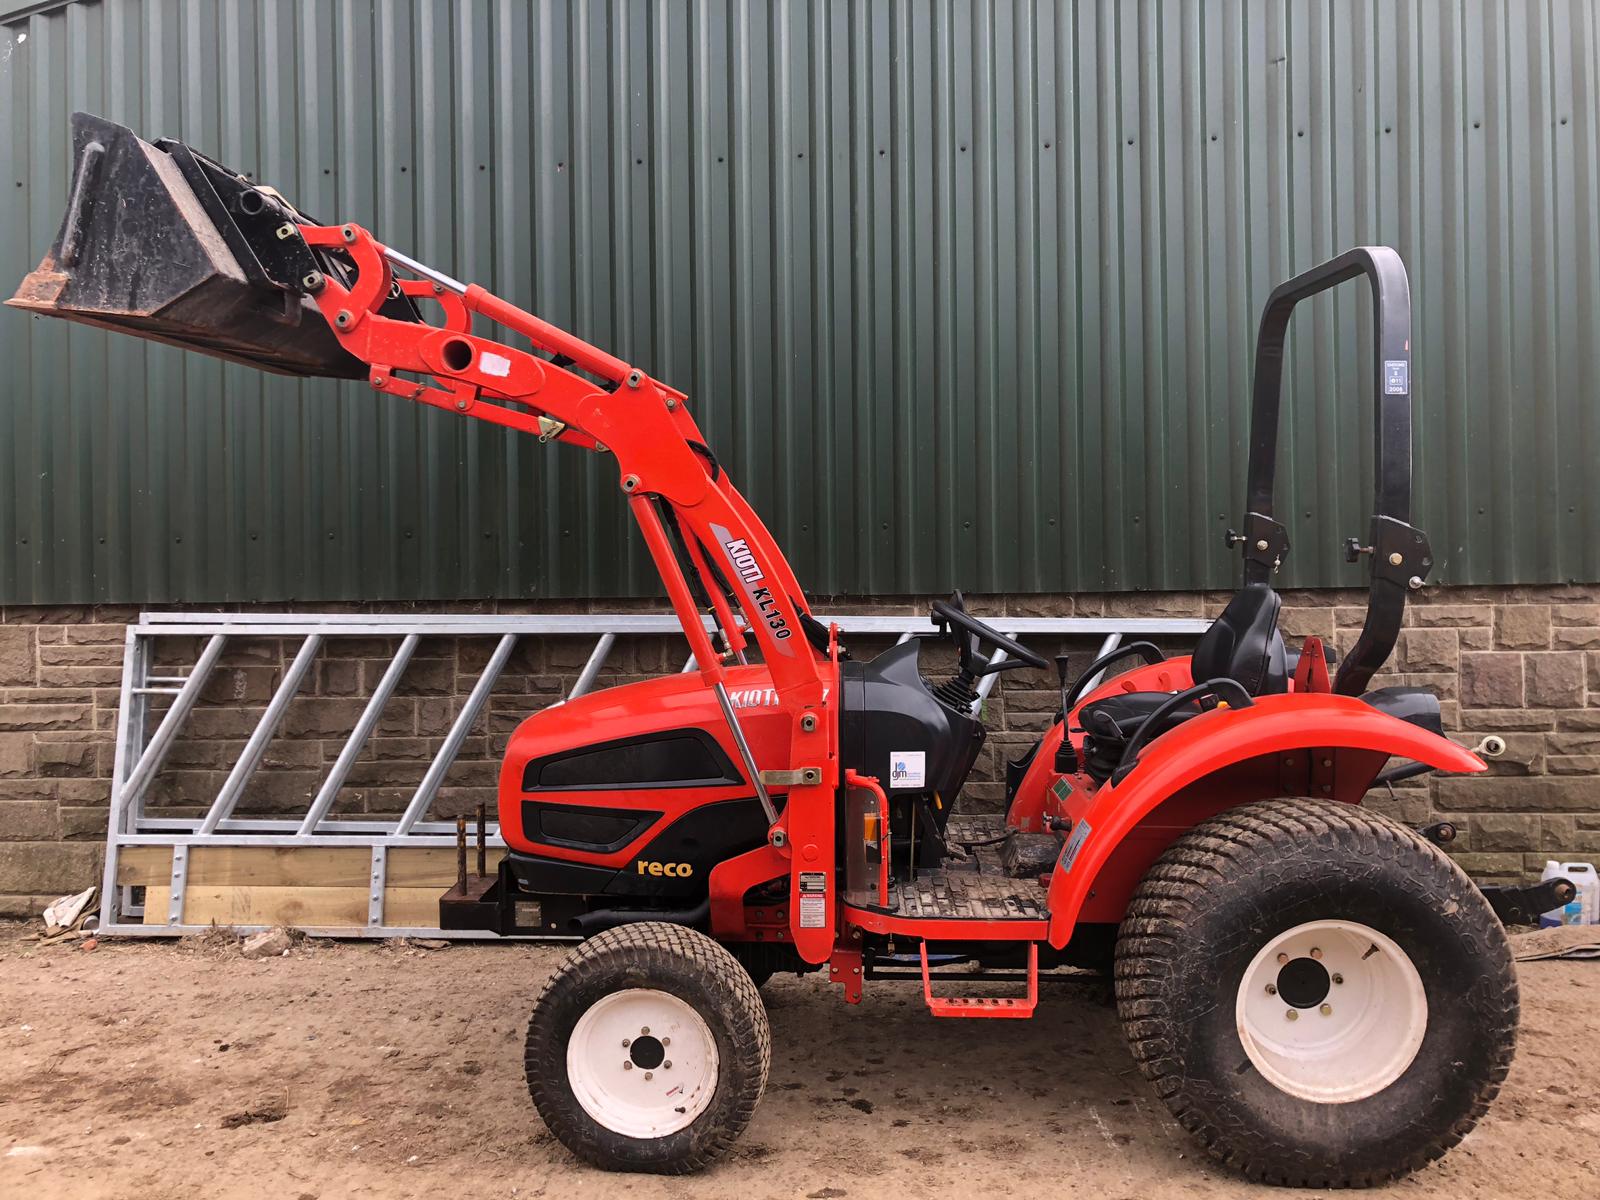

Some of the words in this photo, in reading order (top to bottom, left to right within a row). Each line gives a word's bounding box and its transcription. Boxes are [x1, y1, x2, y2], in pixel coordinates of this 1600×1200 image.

[725, 538, 764, 584] KIOTI
[753, 587, 791, 639] KL130
[638, 860, 693, 877] reco
